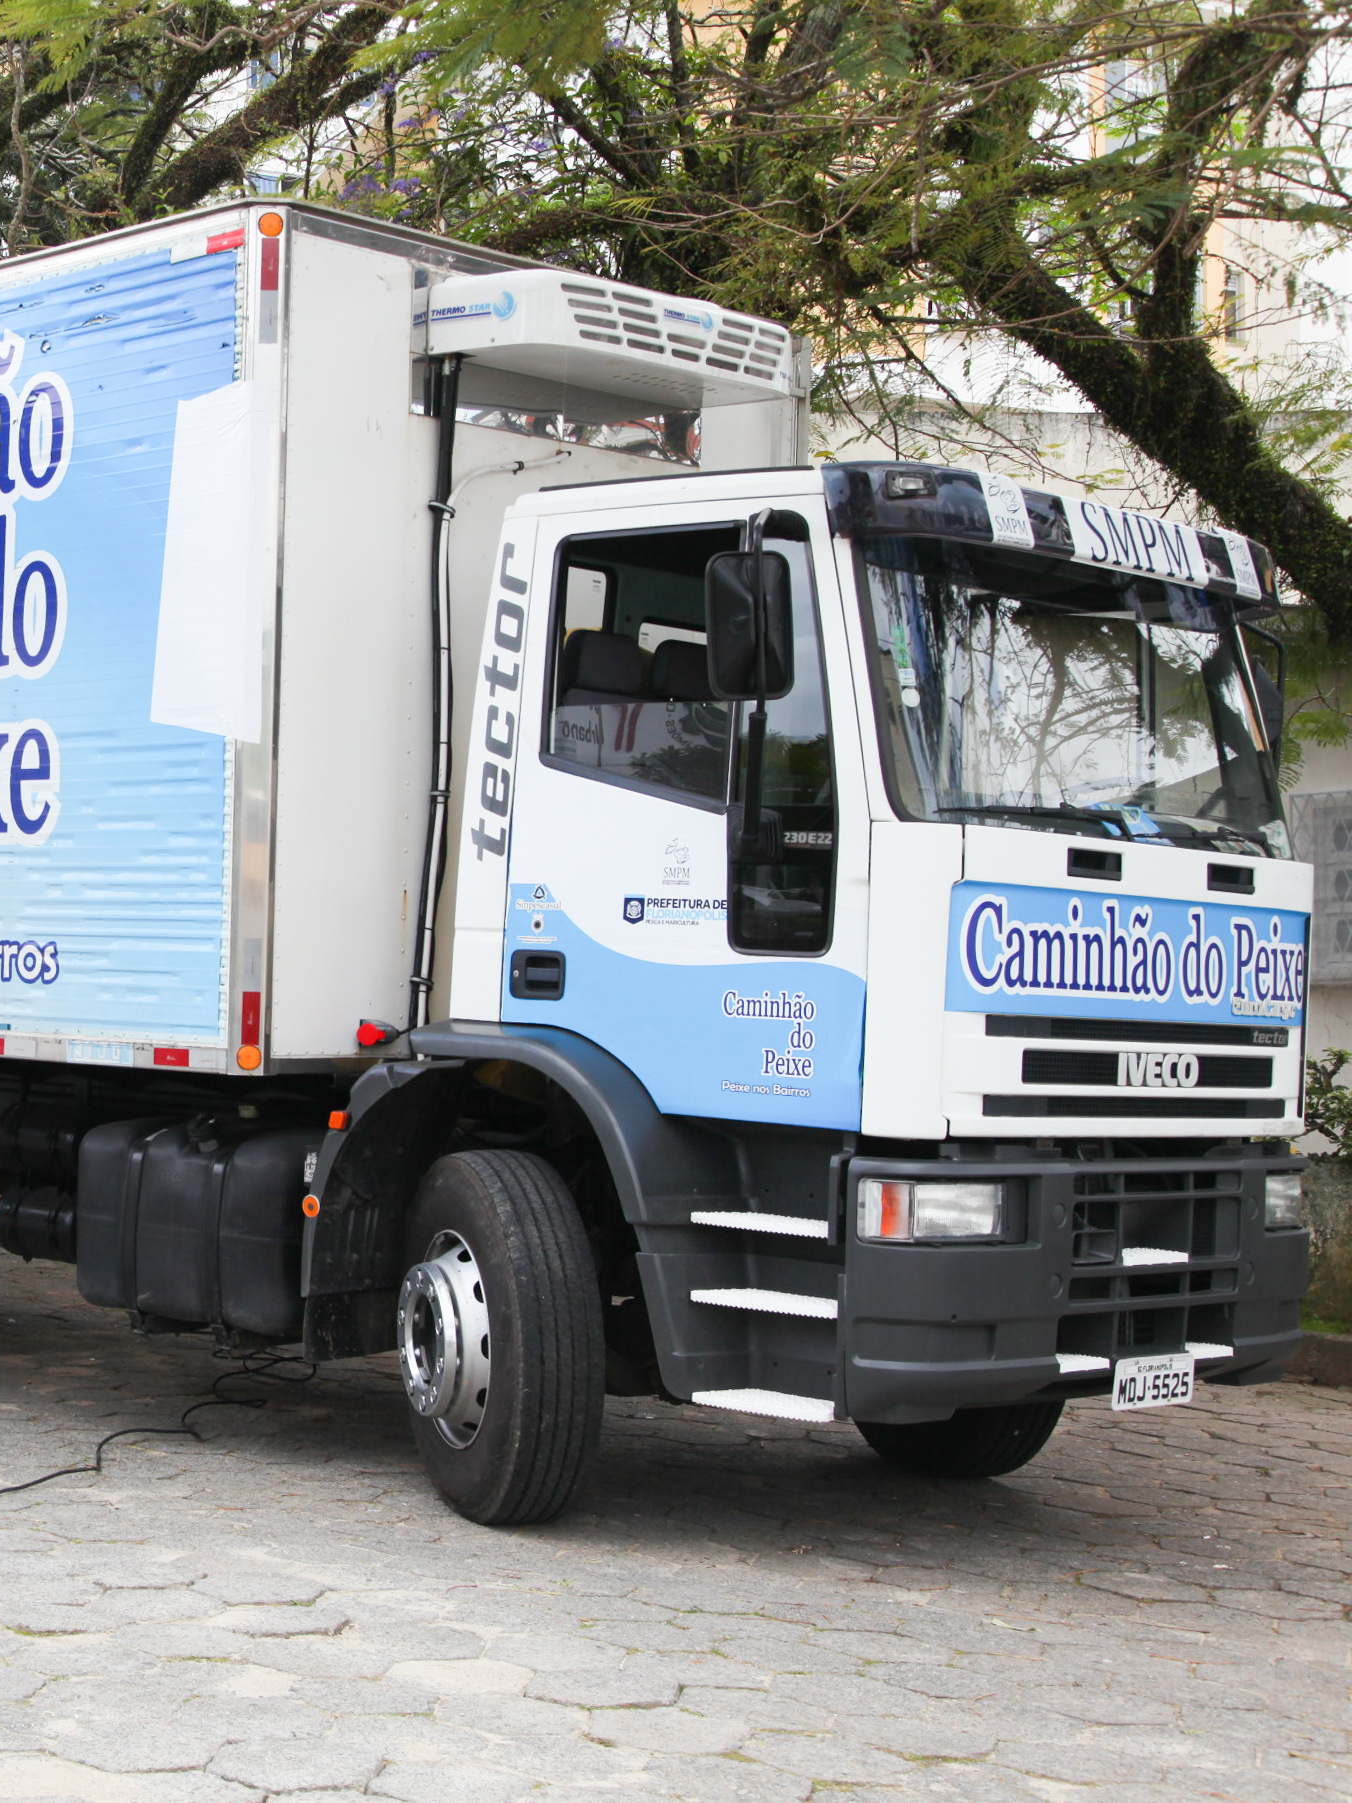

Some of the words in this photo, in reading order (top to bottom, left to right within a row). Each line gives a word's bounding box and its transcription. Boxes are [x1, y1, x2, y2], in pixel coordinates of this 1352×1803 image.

[431, 306, 465, 317] THERMO
[469, 303, 490, 312] STAR
[664, 309, 685, 319] THERMO
[995, 515, 1029, 536] SMPM
[1081, 501, 1195, 581] SMPM
[470, 542, 528, 862] tector
[783, 832, 832, 844] 230E22
[663, 867, 690, 878] SMPM
[647, 898, 710, 909] PREFEITURA
[712, 900, 728, 909] DE
[966, 900, 1171, 996] Caminhão
[1182, 914, 1223, 999] do
[1233, 921, 1303, 1003] Peixe
[723, 991, 814, 1020] Caminhão
[790, 1022, 813, 1049] do
[764, 1049, 812, 1077] Peixe
[1117, 1052, 1198, 1088] IVECO
[722, 1080, 750, 1093] Peixe
[753, 1085, 770, 1094] nos
[773, 1084, 811, 1097] Bairros
